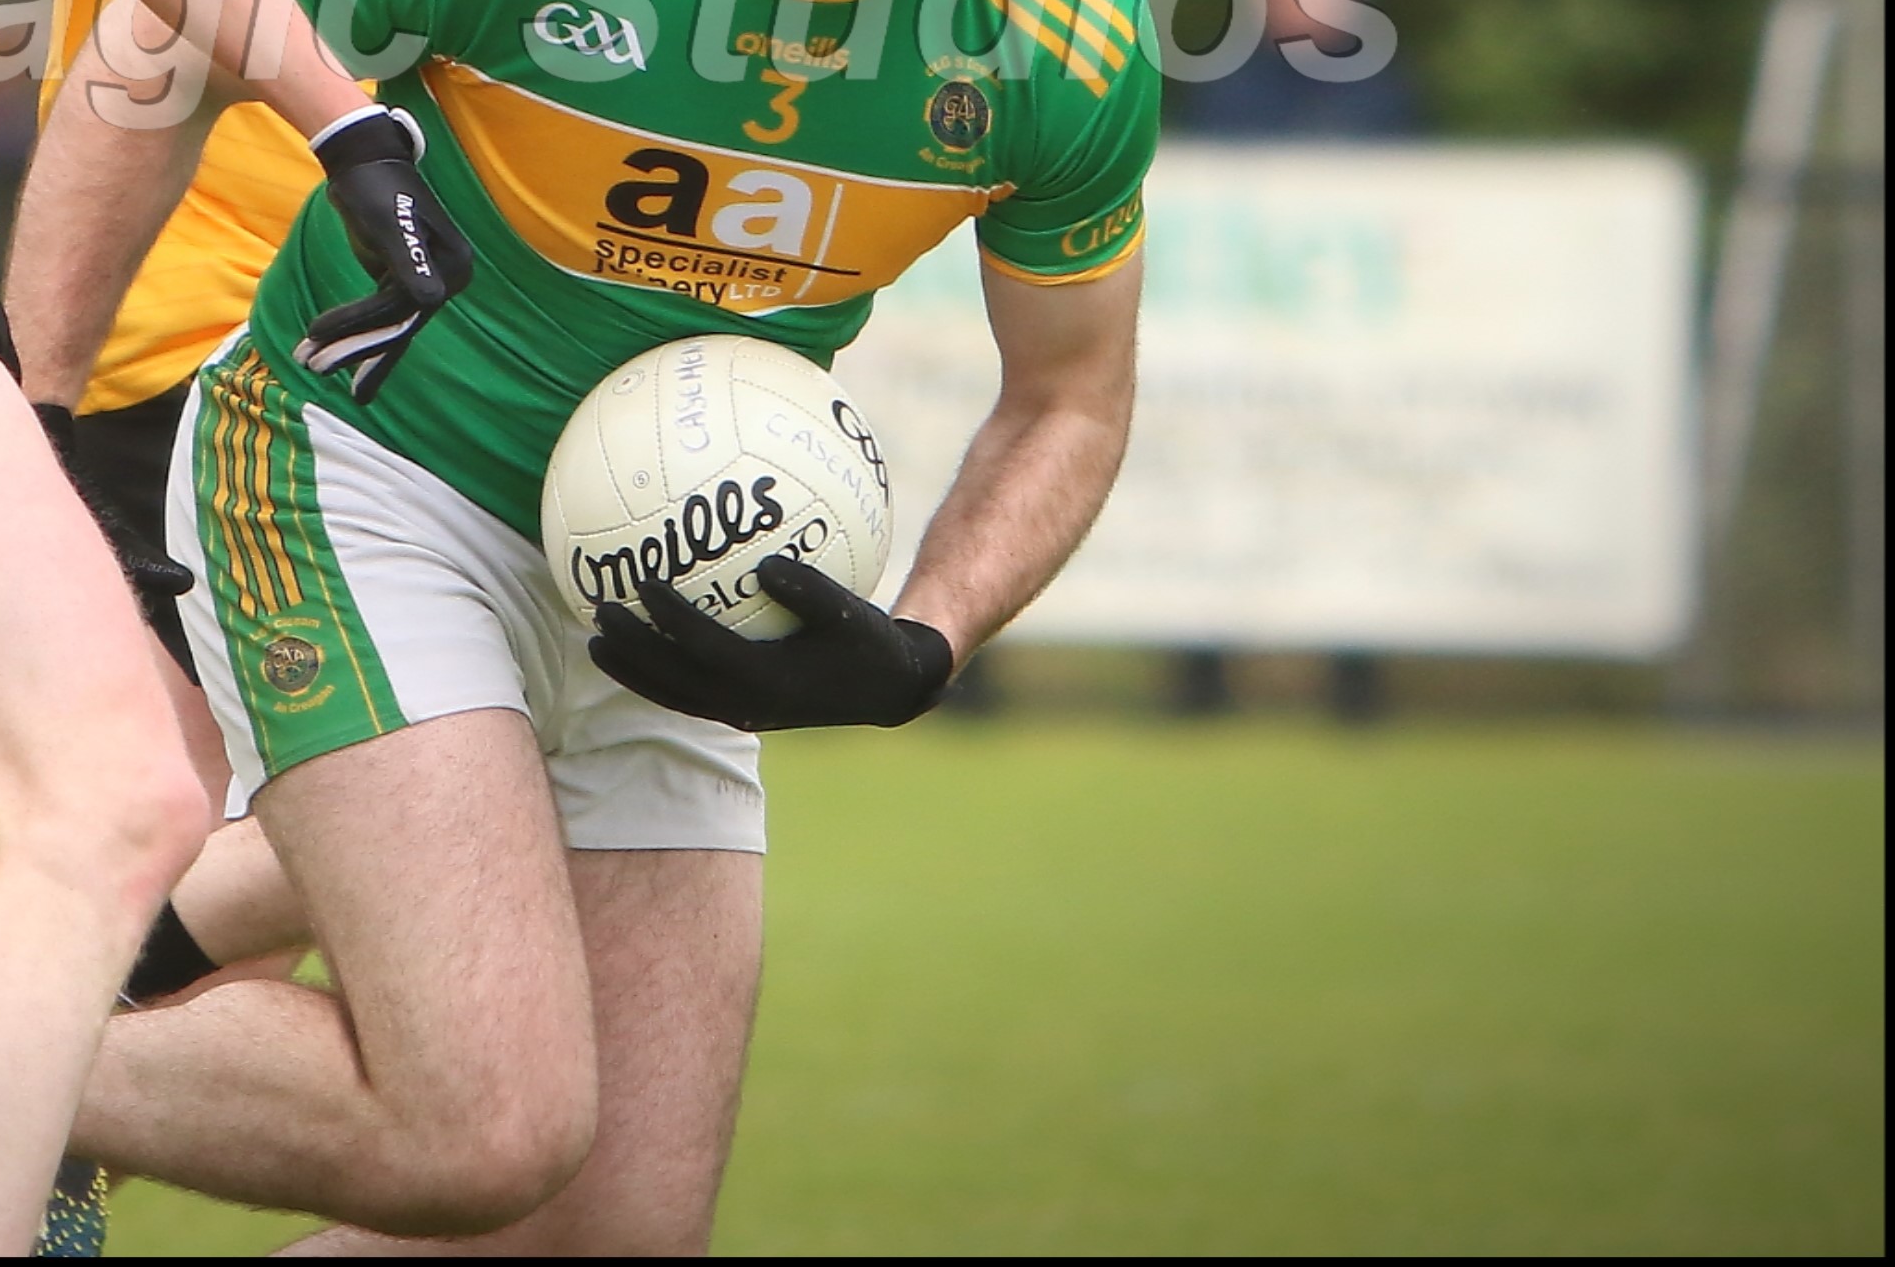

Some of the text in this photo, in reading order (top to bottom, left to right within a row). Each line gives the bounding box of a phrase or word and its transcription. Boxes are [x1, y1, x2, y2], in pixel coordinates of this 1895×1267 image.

[741, 71, 809, 144] 3
[395, 193, 432, 277] IMPACT
[605, 147, 812, 258] aa
[594, 238, 788, 283] specialist
[727, 283, 782, 301] LTD
